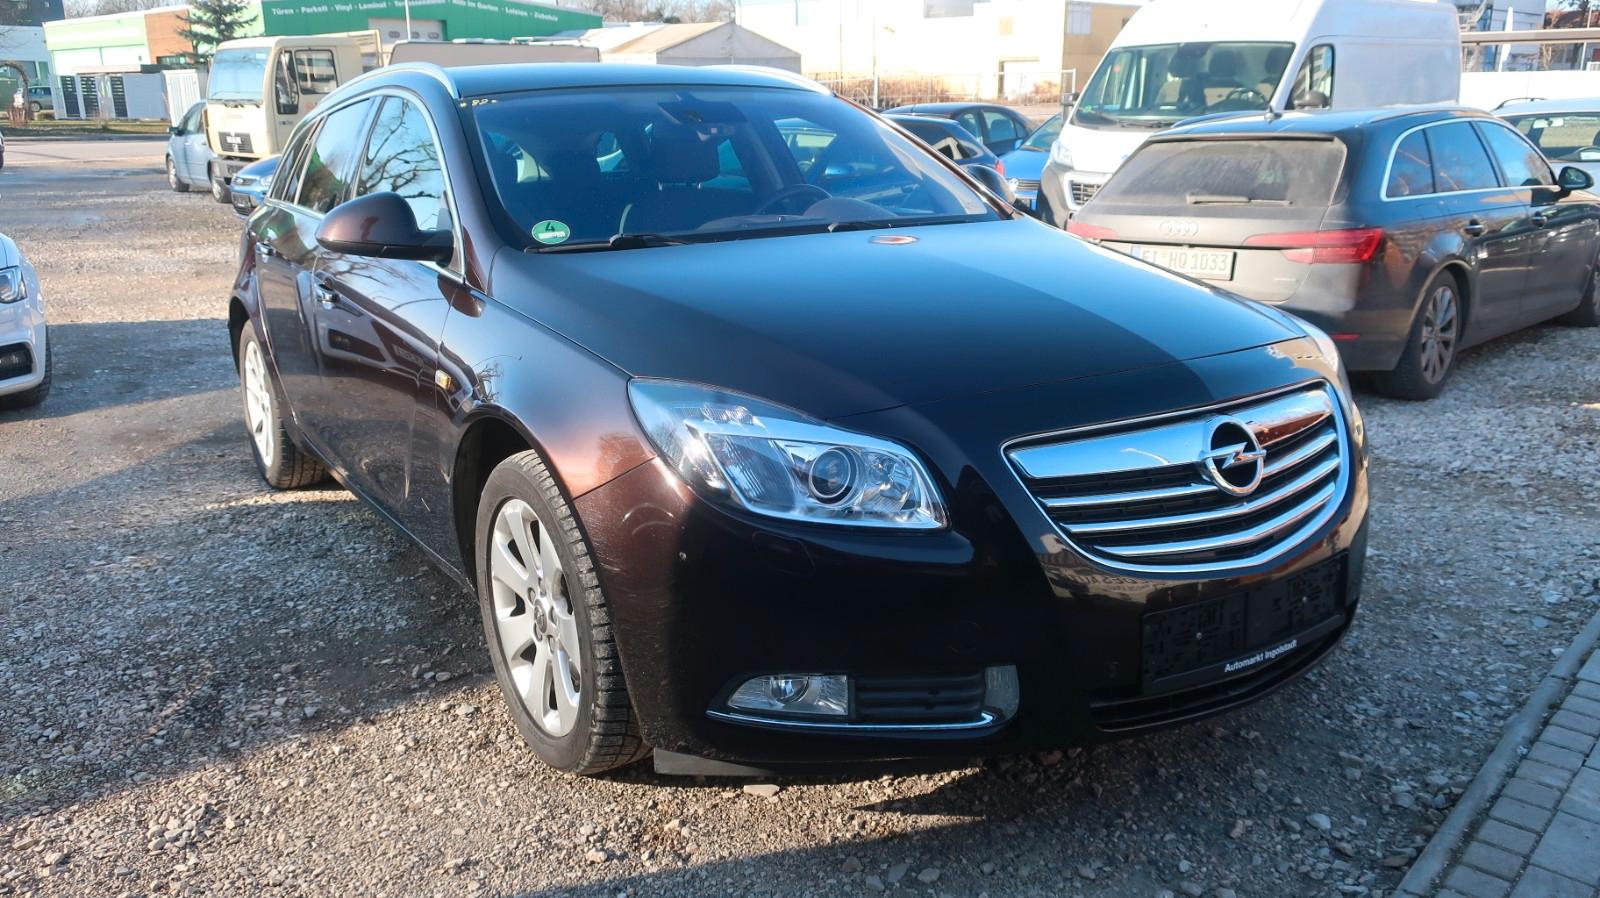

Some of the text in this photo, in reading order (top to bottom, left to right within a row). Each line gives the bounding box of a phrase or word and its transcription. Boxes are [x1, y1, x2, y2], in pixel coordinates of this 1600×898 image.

[300, 5, 328, 14] Parkett
[334, 4, 352, 12] Vinyl
[358, 1, 387, 10] Laminat
[545, 222, 555, 232] 4
[1190, 252, 1228, 272] 1033
[1224, 640, 1297, 673] Automarkt Ingolstadt
